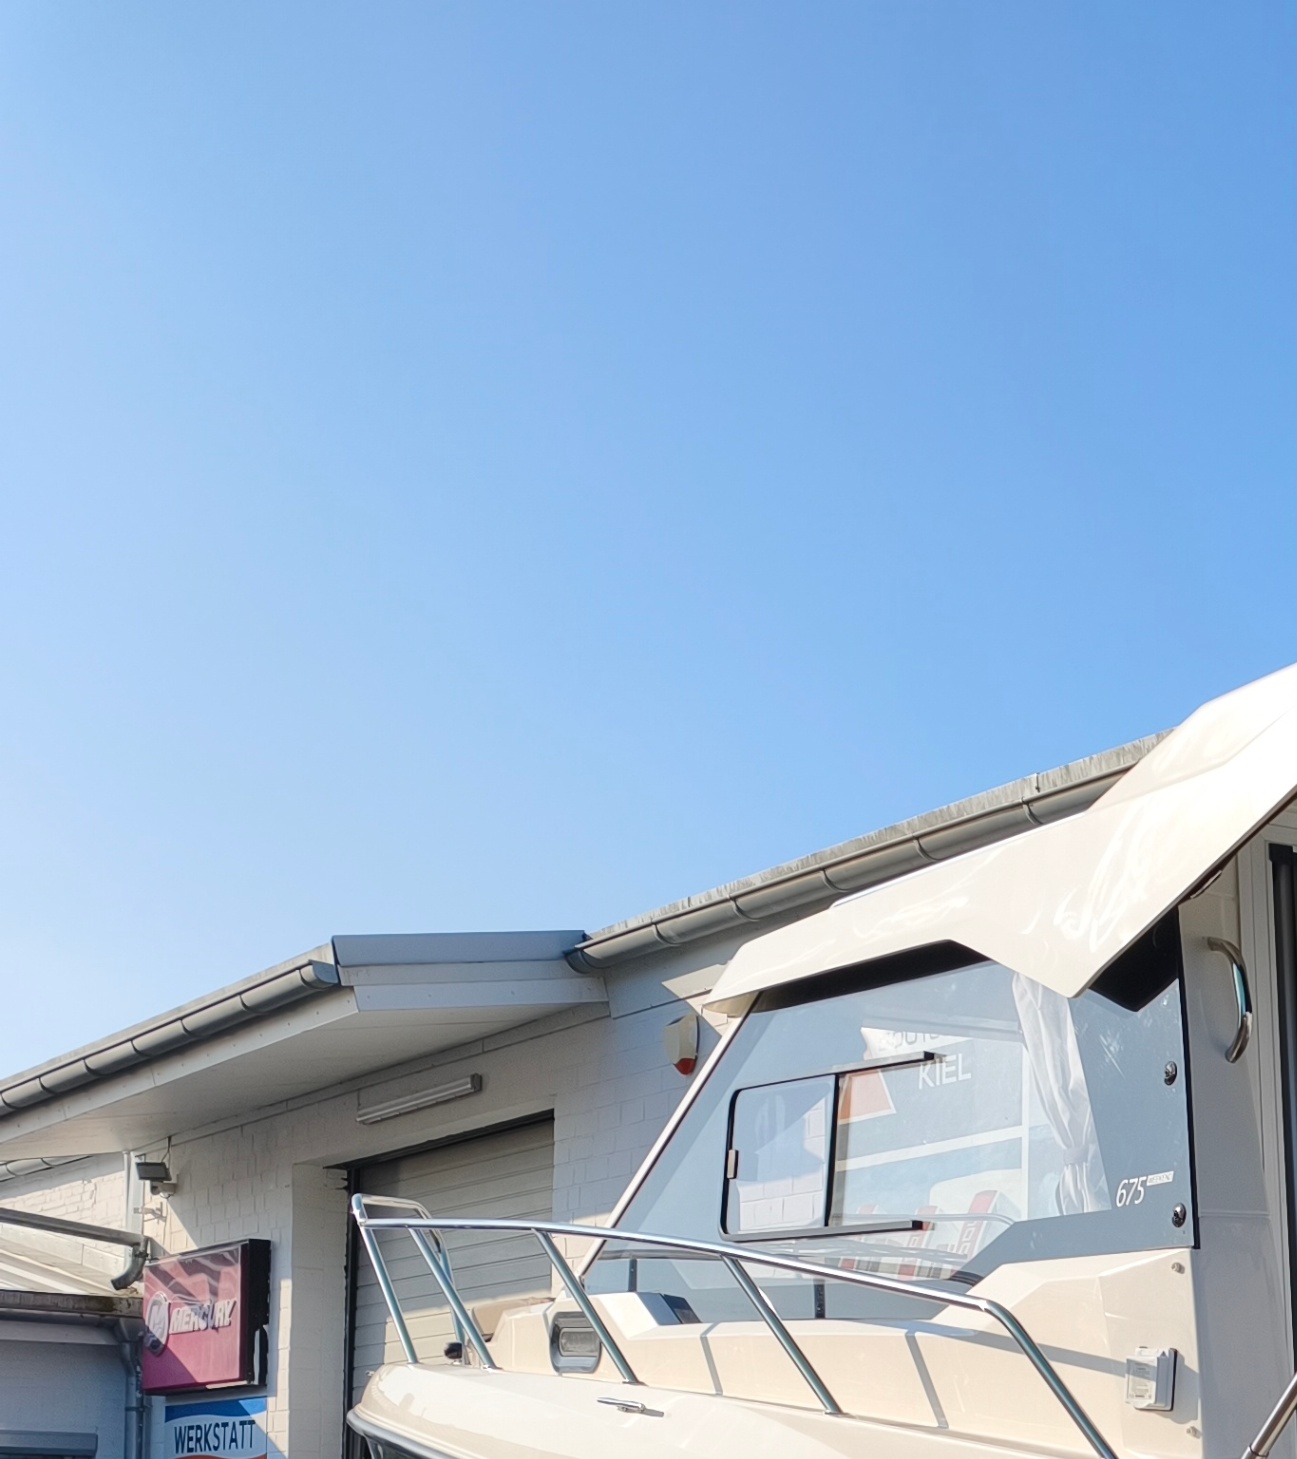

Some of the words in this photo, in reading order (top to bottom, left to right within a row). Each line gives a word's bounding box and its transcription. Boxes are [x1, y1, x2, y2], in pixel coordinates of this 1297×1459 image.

[918, 1052, 972, 1090] KIEL
[1115, 1175, 1148, 1208] 675
[169, 1299, 237, 1335] MERCURY
[174, 1419, 256, 1454] WERKSTATT
